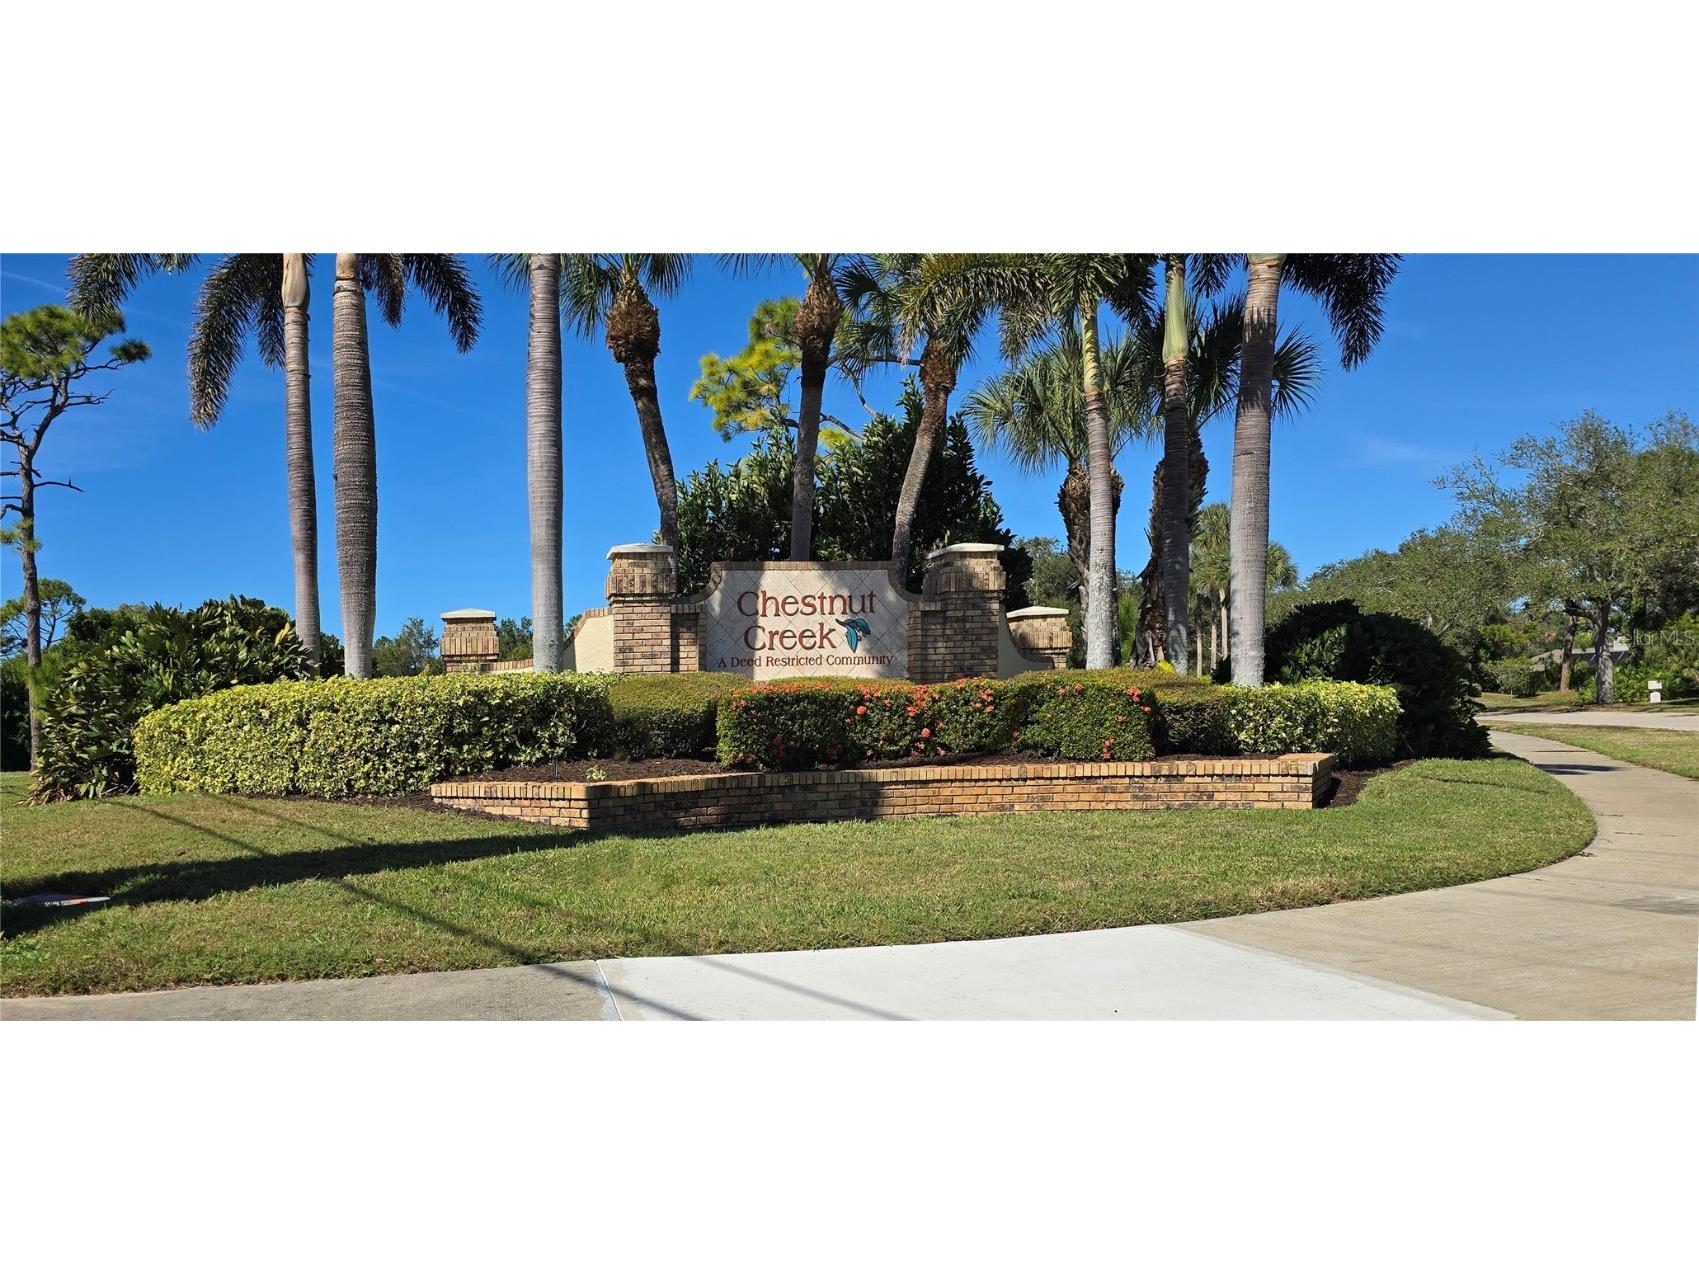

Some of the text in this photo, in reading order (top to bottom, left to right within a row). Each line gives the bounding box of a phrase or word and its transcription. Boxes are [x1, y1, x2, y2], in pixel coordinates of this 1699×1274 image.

[737, 589, 877, 617] Chestnut
[743, 622, 837, 651] Creek
[717, 654, 894, 669] A Deed Restricted Community
